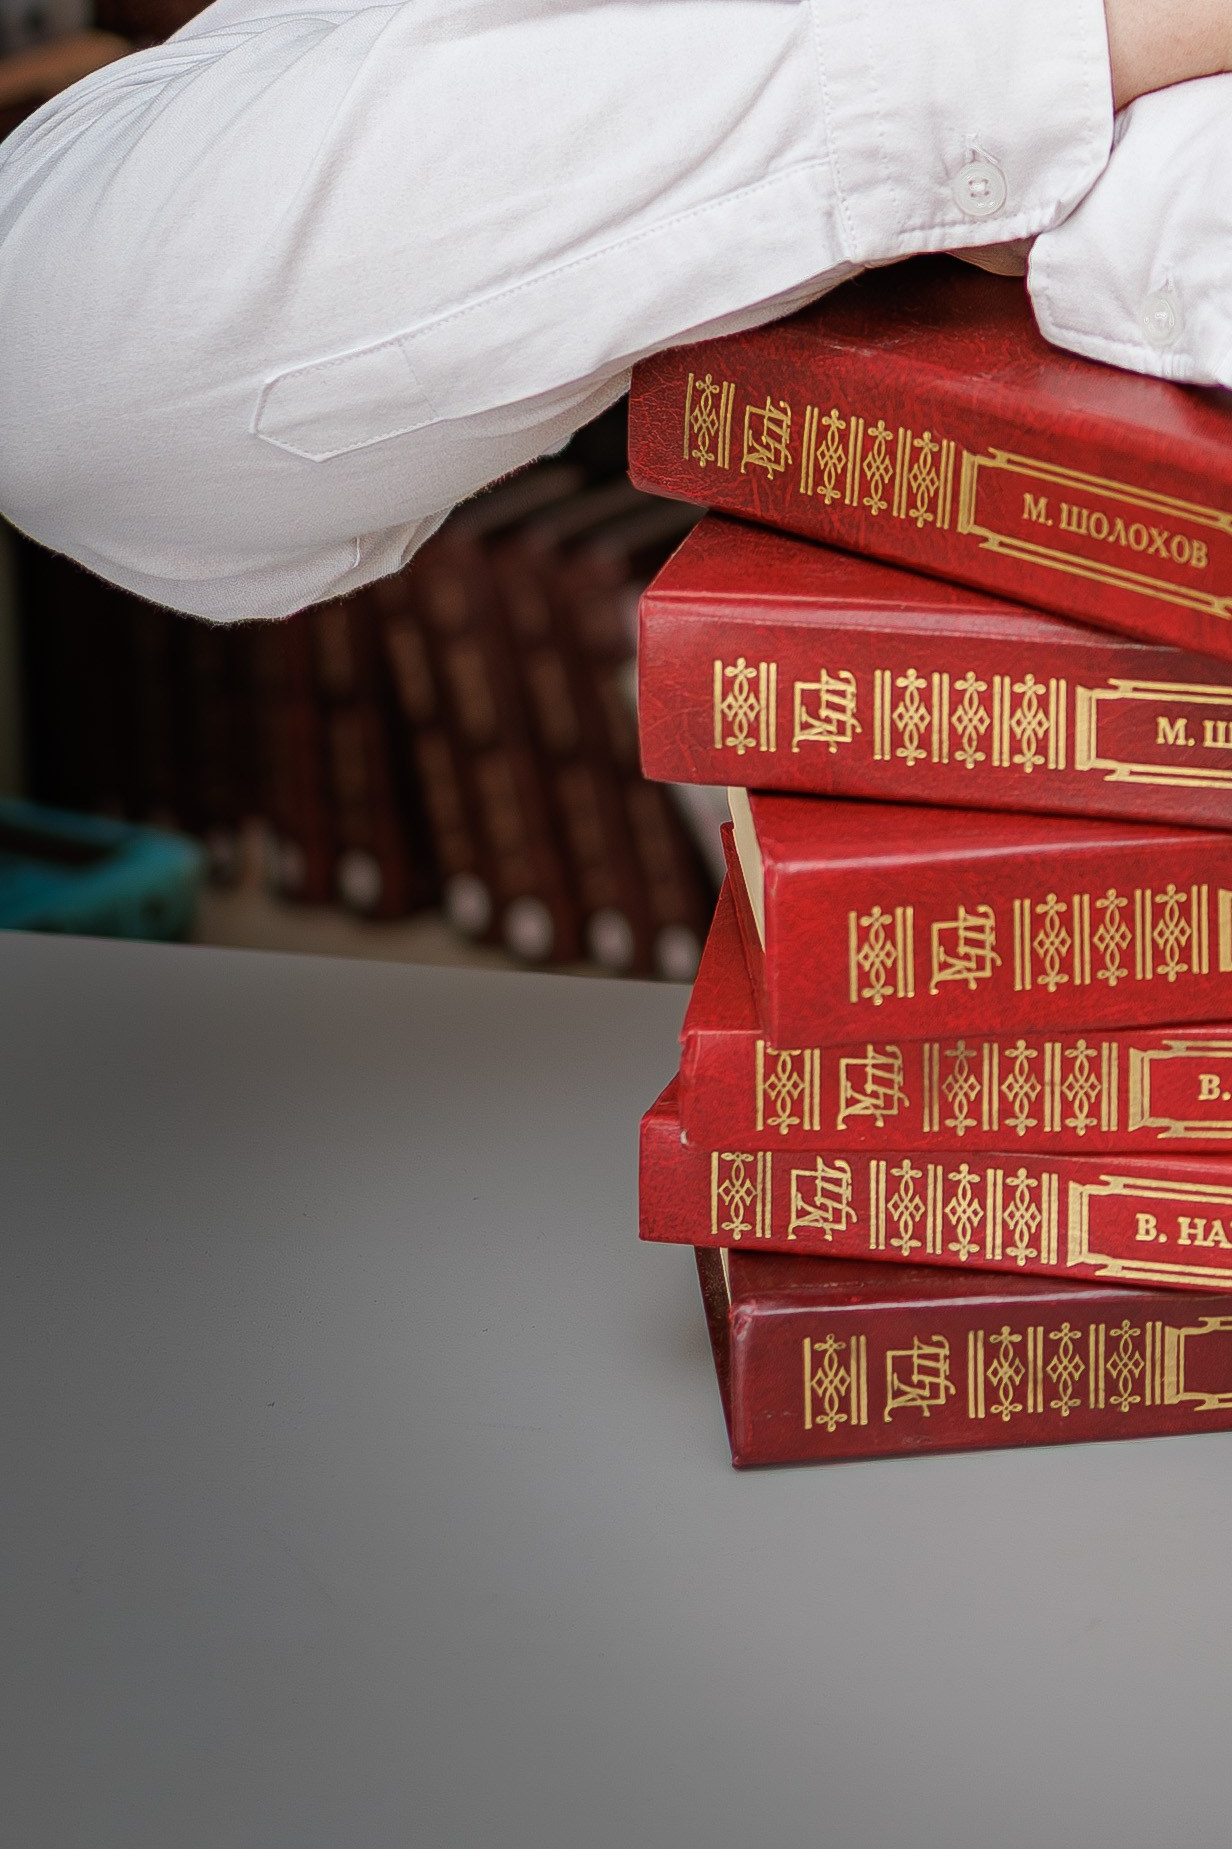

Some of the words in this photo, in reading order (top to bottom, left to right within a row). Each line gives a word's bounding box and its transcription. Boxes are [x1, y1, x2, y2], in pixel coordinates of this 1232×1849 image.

[1022, 492, 1053, 526] М.
[1058, 501, 1209, 569] ШОЛОХОВ
[1155, 716, 1195, 747] М.
[1197, 1073, 1232, 1101] В.
[1134, 1212, 1168, 1244] В.
